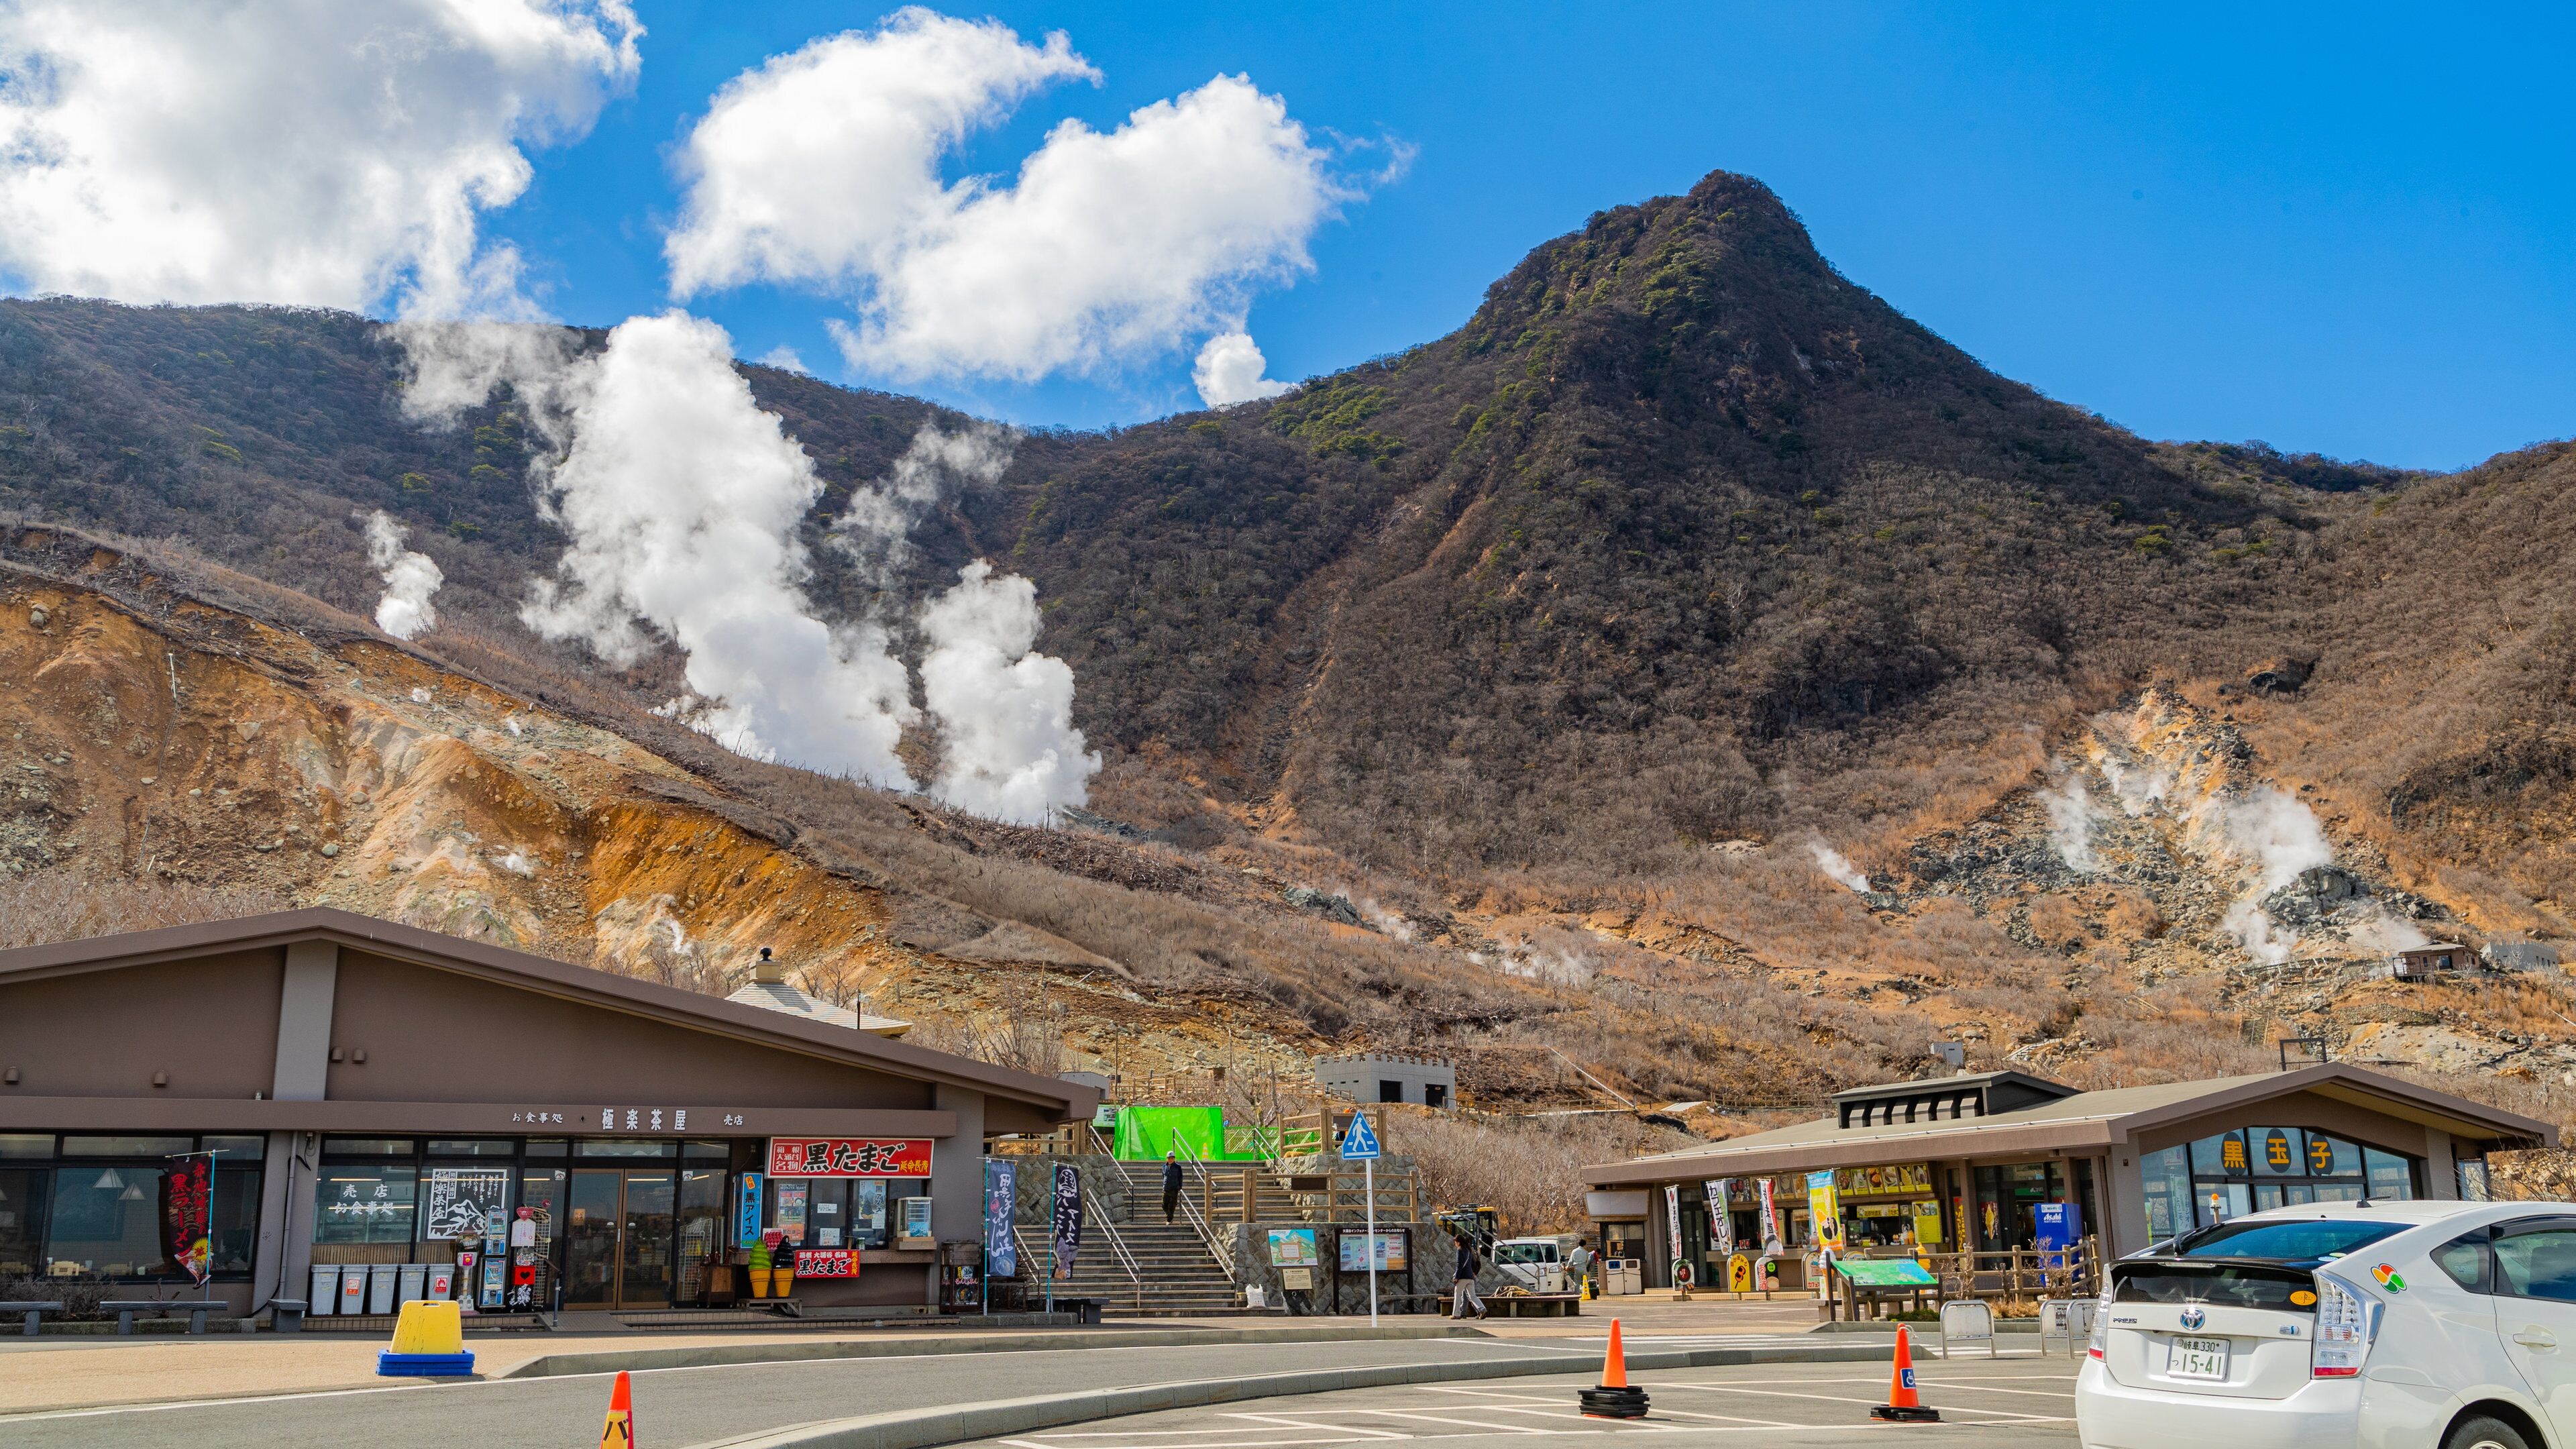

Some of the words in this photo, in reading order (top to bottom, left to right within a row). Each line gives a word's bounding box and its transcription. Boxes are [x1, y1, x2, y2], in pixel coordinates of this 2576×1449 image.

[513, 1112, 563, 1124] お食事処
[602, 1108, 686, 1130] 極楽茶屋
[724, 1114, 743, 1126] 売店
[777, 1146, 800, 1154] 箱根
[801, 1142, 907, 1173] 黒たまご
[2224, 1138, 2331, 1169] 黒玉子
[775, 1161, 799, 1171] 名物
[343, 1184, 388, 1198] 売店
[431, 1171, 448, 1218] 極楽茶屋
[170, 1174, 192, 1256] 黒ラーメン
[334, 1200, 394, 1216] お食事処
[744, 1192, 755, 1236] 黒アイス
[1709, 1185, 1728, 1238] カフェオレ
[2043, 1213, 2062, 1221] Asahi
[797, 1258, 852, 1276] 黒たまご
[2184, 1340, 2199, 1350] 岐阜
[2200, 1341, 2216, 1352] 330
[2182, 1353, 2222, 1375] 15-41
